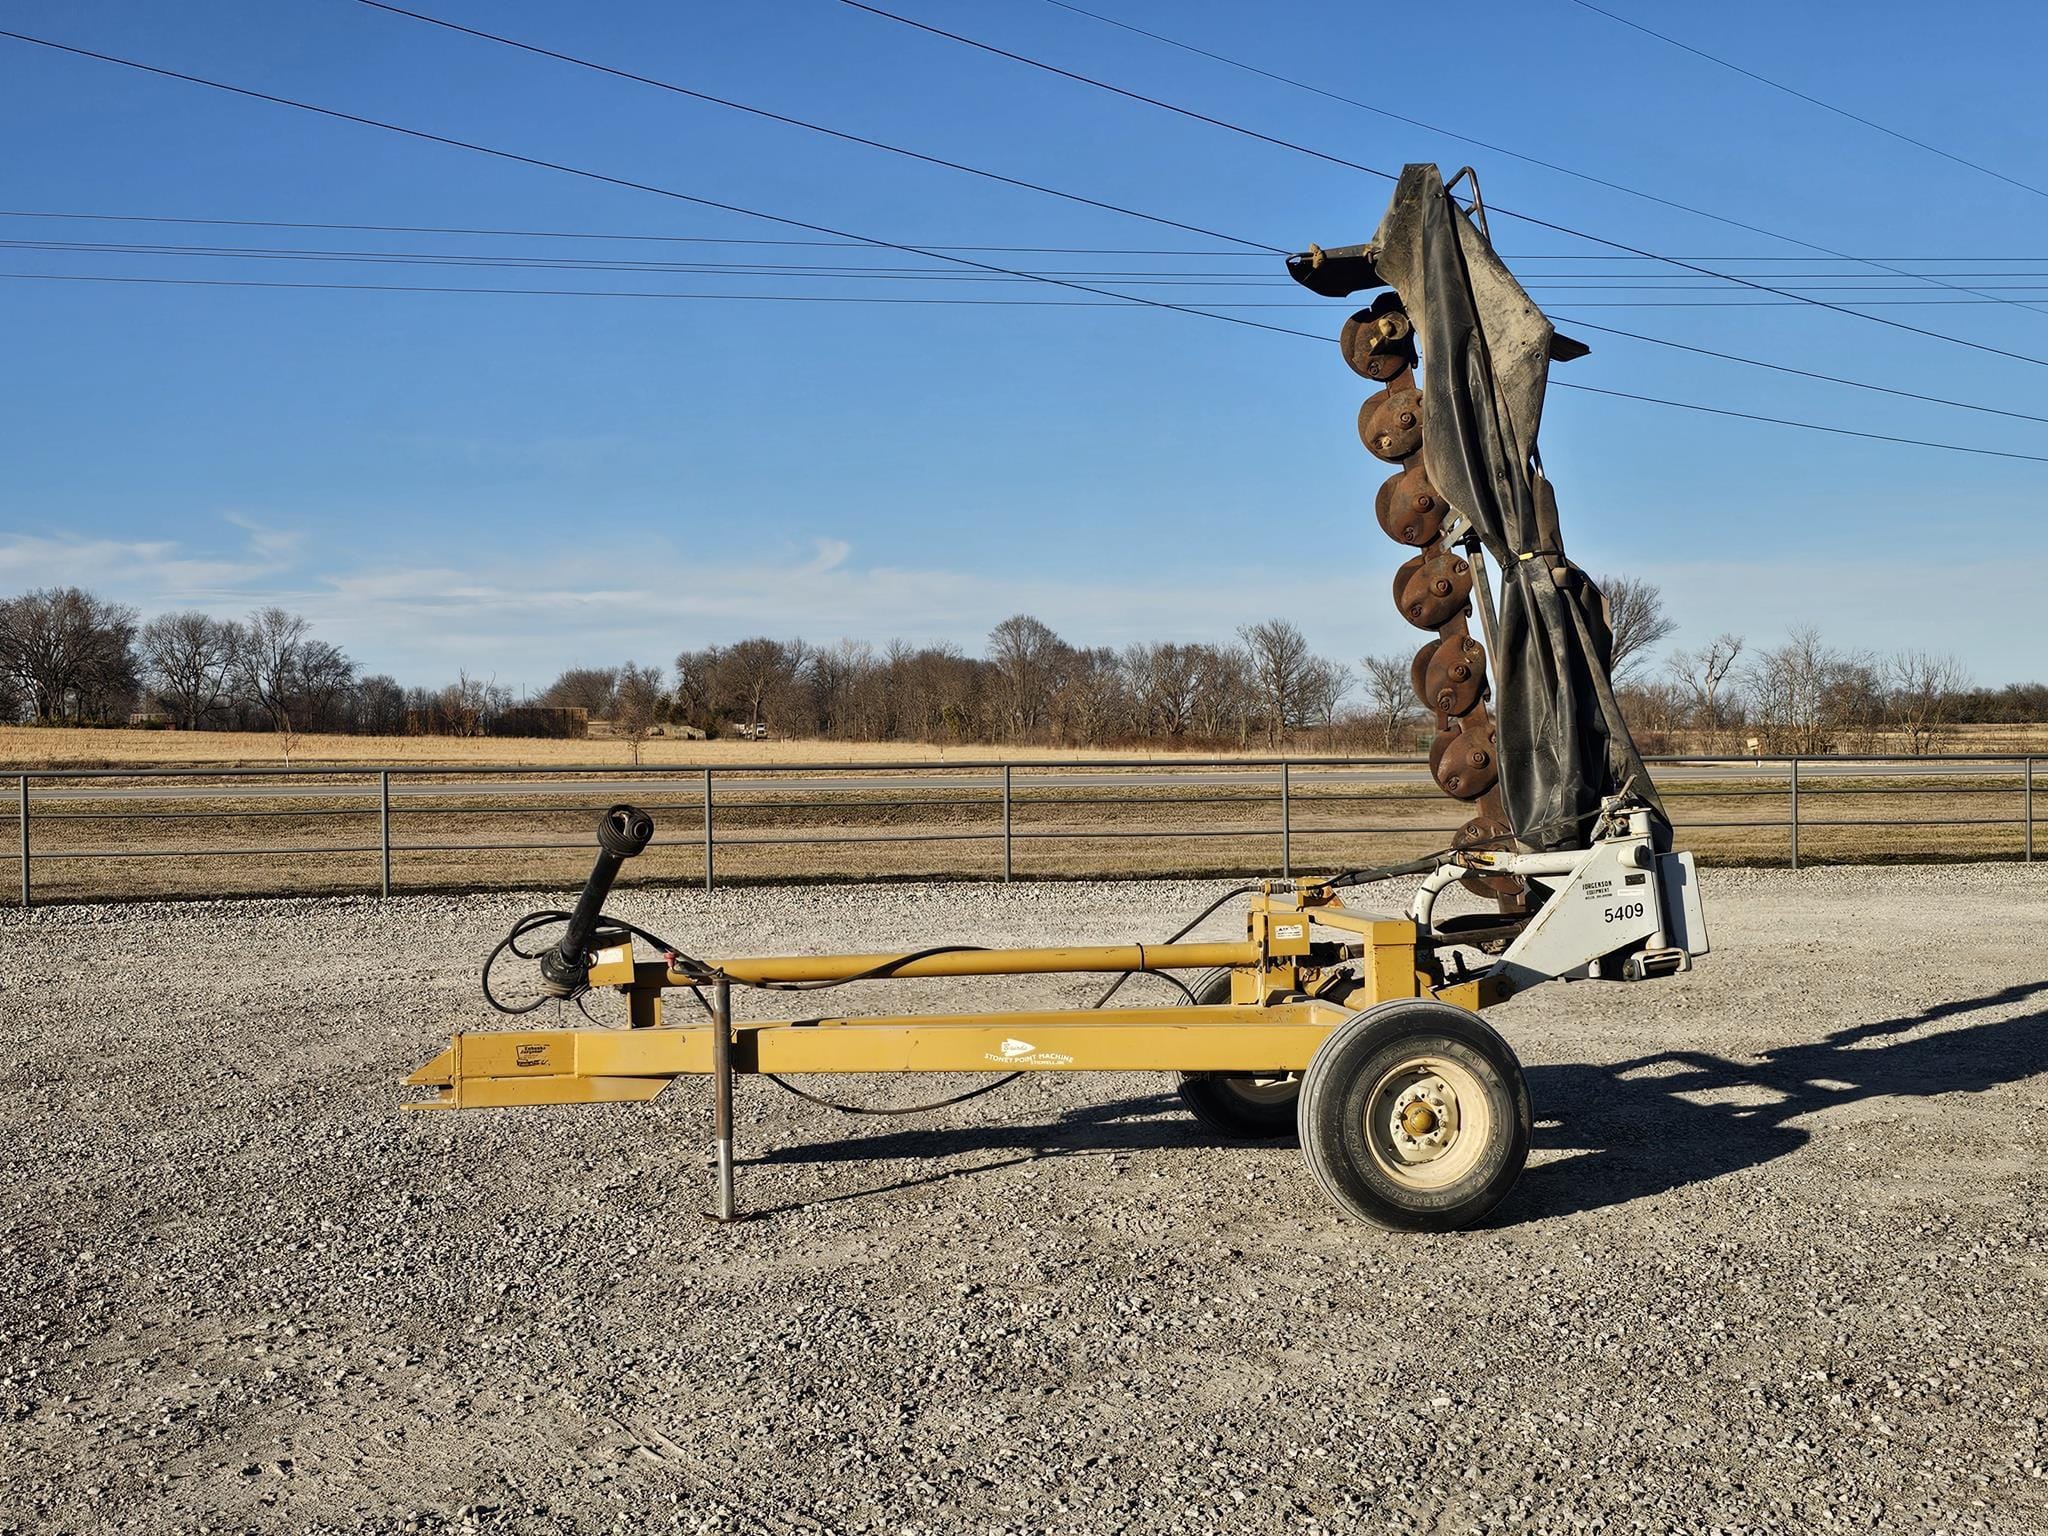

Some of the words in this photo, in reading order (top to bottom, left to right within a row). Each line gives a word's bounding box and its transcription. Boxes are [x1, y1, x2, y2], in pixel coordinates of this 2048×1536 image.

[1582, 880, 1612, 890] JORGENSON
[1604, 902, 1644, 923] 5409
[984, 1053, 1013, 1064] STONEY
[1014, 1054, 1036, 1063] POINT
[1038, 1053, 1074, 1064] MACHINE
